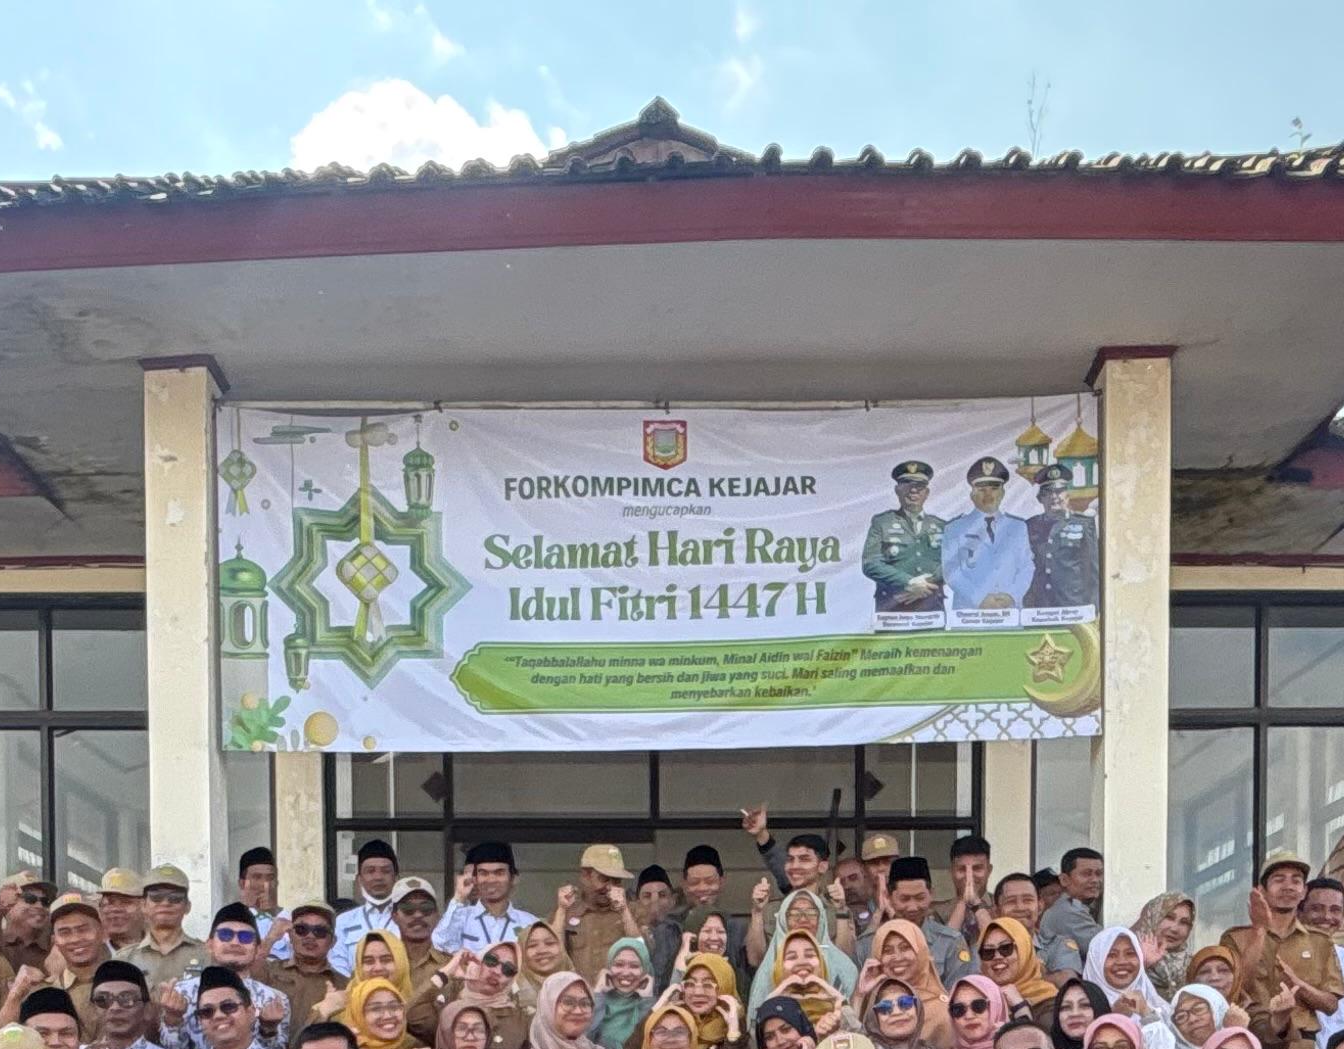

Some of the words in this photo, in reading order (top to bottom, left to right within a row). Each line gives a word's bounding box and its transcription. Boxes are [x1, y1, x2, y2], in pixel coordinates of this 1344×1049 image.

[503, 475, 702, 500] FORKOMPIMCA
[708, 475, 817, 497] KEJAJAR
[622, 503, 712, 519] mengucapkan
[483, 533, 639, 570] Selamat
[648, 527, 736, 566] Hari
[745, 527, 842, 573] Raya
[509, 586, 581, 621] Idul
[590, 583, 678, 622] Fitri
[687, 582, 789, 619] 1447
[796, 581, 827, 615] H
[608, 656, 646, 667] minna
[648, 657, 666, 667] wa
[668, 654, 720, 667] minkum,
[723, 652, 757, 665] Minal
[758, 651, 790, 664] Aidin
[792, 650, 814, 662] wal
[860, 647, 902, 661] Meraih
[904, 646, 983, 660] kemenangan
[530, 672, 577, 687] dengan
[579, 673, 604, 685] hati
[604, 675, 635, 687] yang
[636, 672, 674, 684] bersih
[676, 671, 699, 683] dan
[700, 670, 726, 684] jiwa
[727, 670, 759, 684] yang
[791, 667, 818, 680] Mari
[821, 667, 858, 681] saling
[859, 663, 931, 678] memaafkan
[932, 663, 956, 675] dan
[670, 686, 752, 702] menyebarkan
